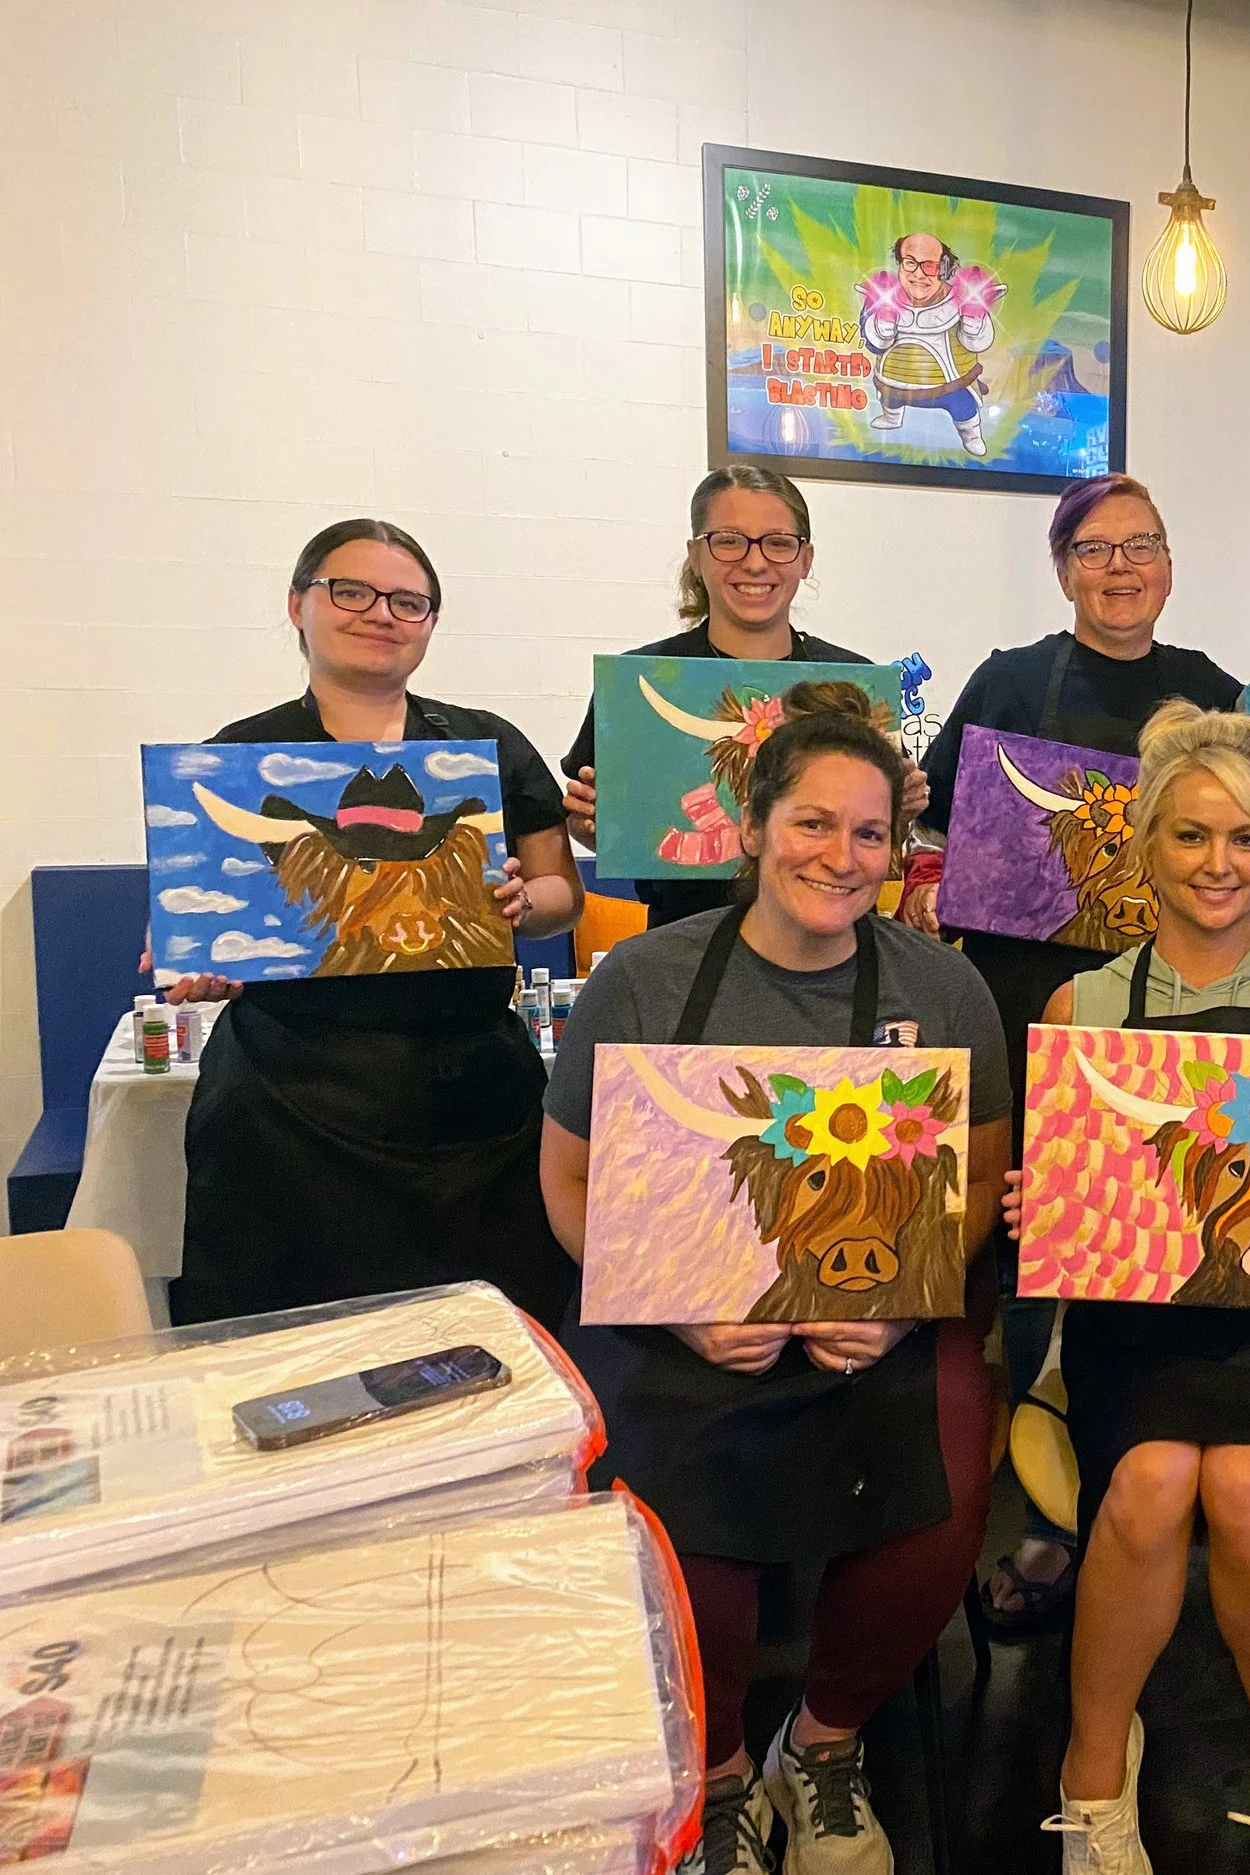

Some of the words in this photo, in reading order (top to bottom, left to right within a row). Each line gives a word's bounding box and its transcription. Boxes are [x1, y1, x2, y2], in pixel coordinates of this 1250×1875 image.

[791, 285, 824, 311] SO
[762, 343, 772, 369] I
[786, 347, 872, 378] STARTED
[766, 377, 868, 410] BLASTING
